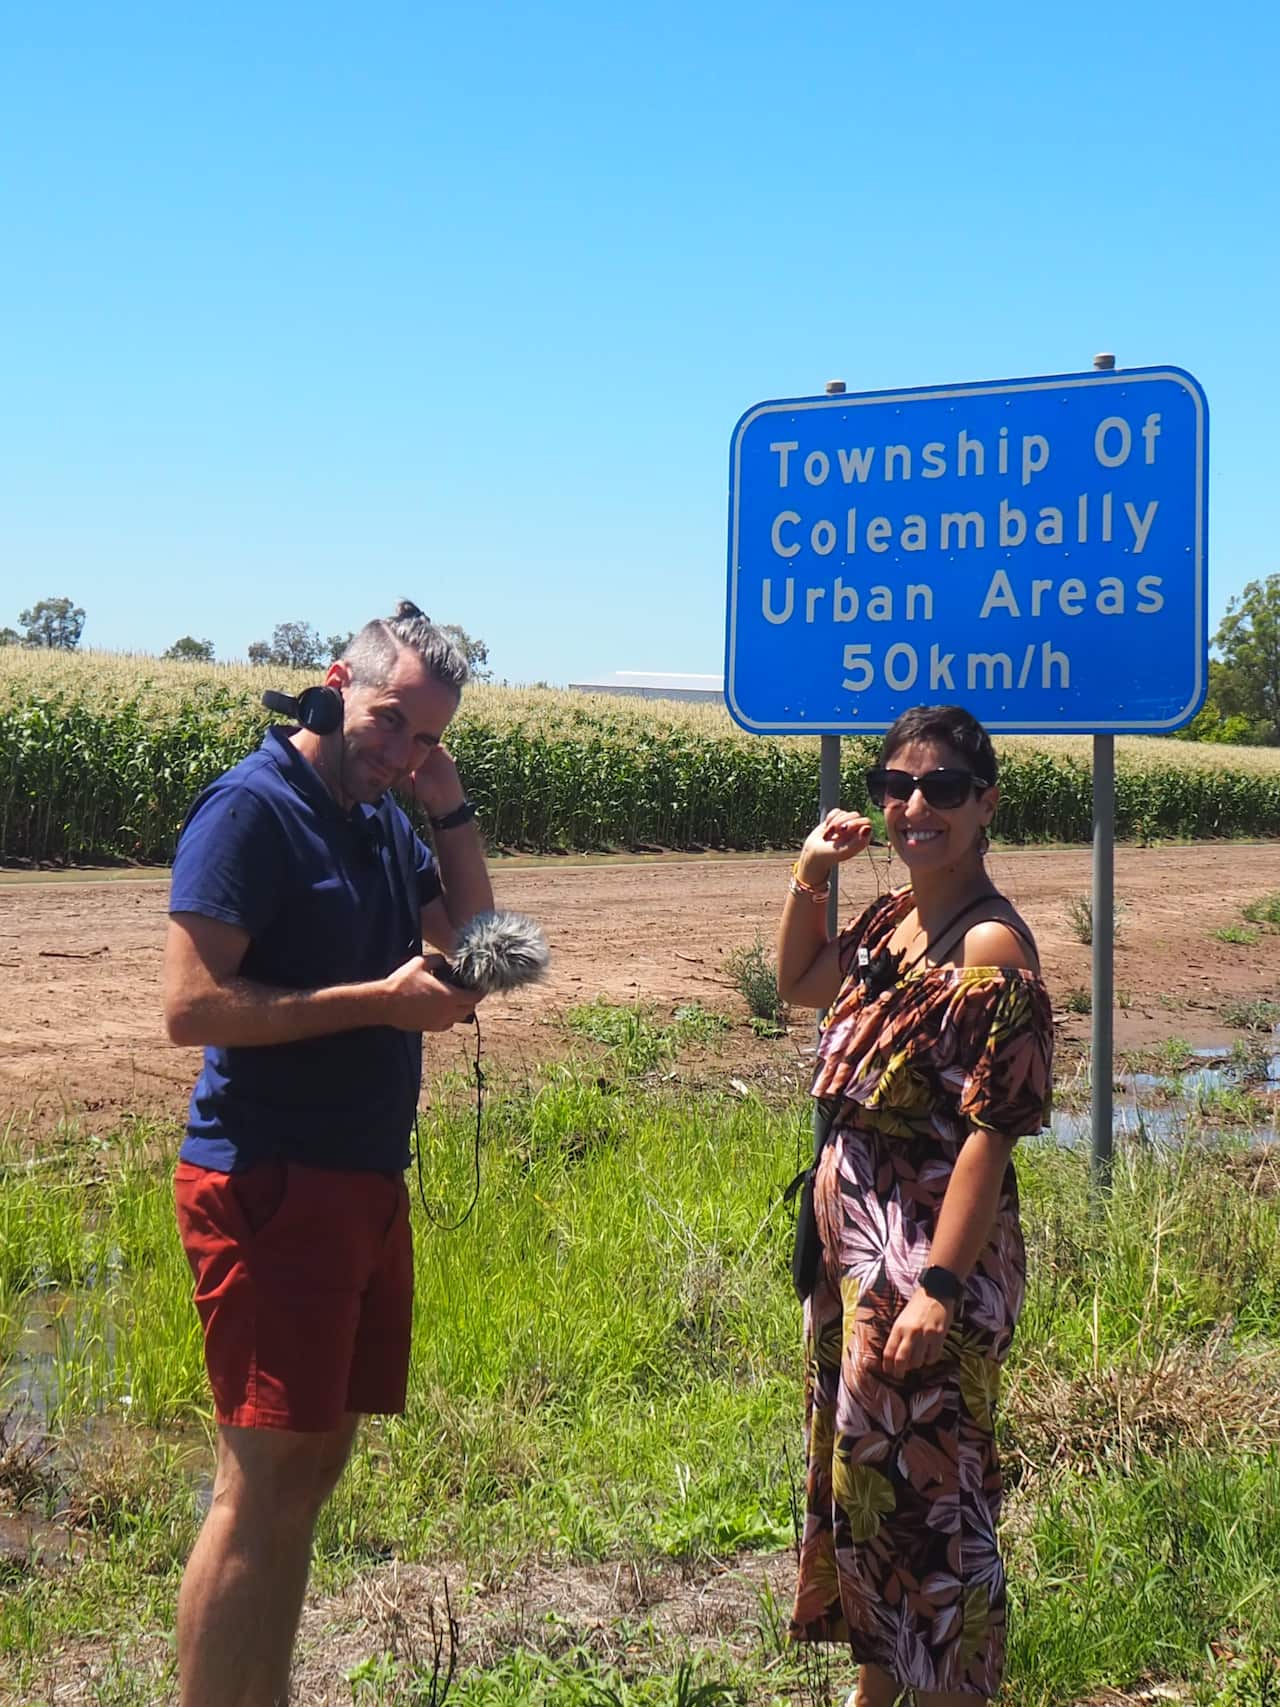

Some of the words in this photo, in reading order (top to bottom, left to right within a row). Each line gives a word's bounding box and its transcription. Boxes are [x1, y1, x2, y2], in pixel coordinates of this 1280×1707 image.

[770, 427, 1050, 487] Township
[1094, 413, 1161, 468] Of
[771, 492, 1159, 558] Coleambally
[762, 576, 933, 625] Urban
[979, 569, 1165, 619] Areas
[841, 641, 1070, 692] 50km/h
